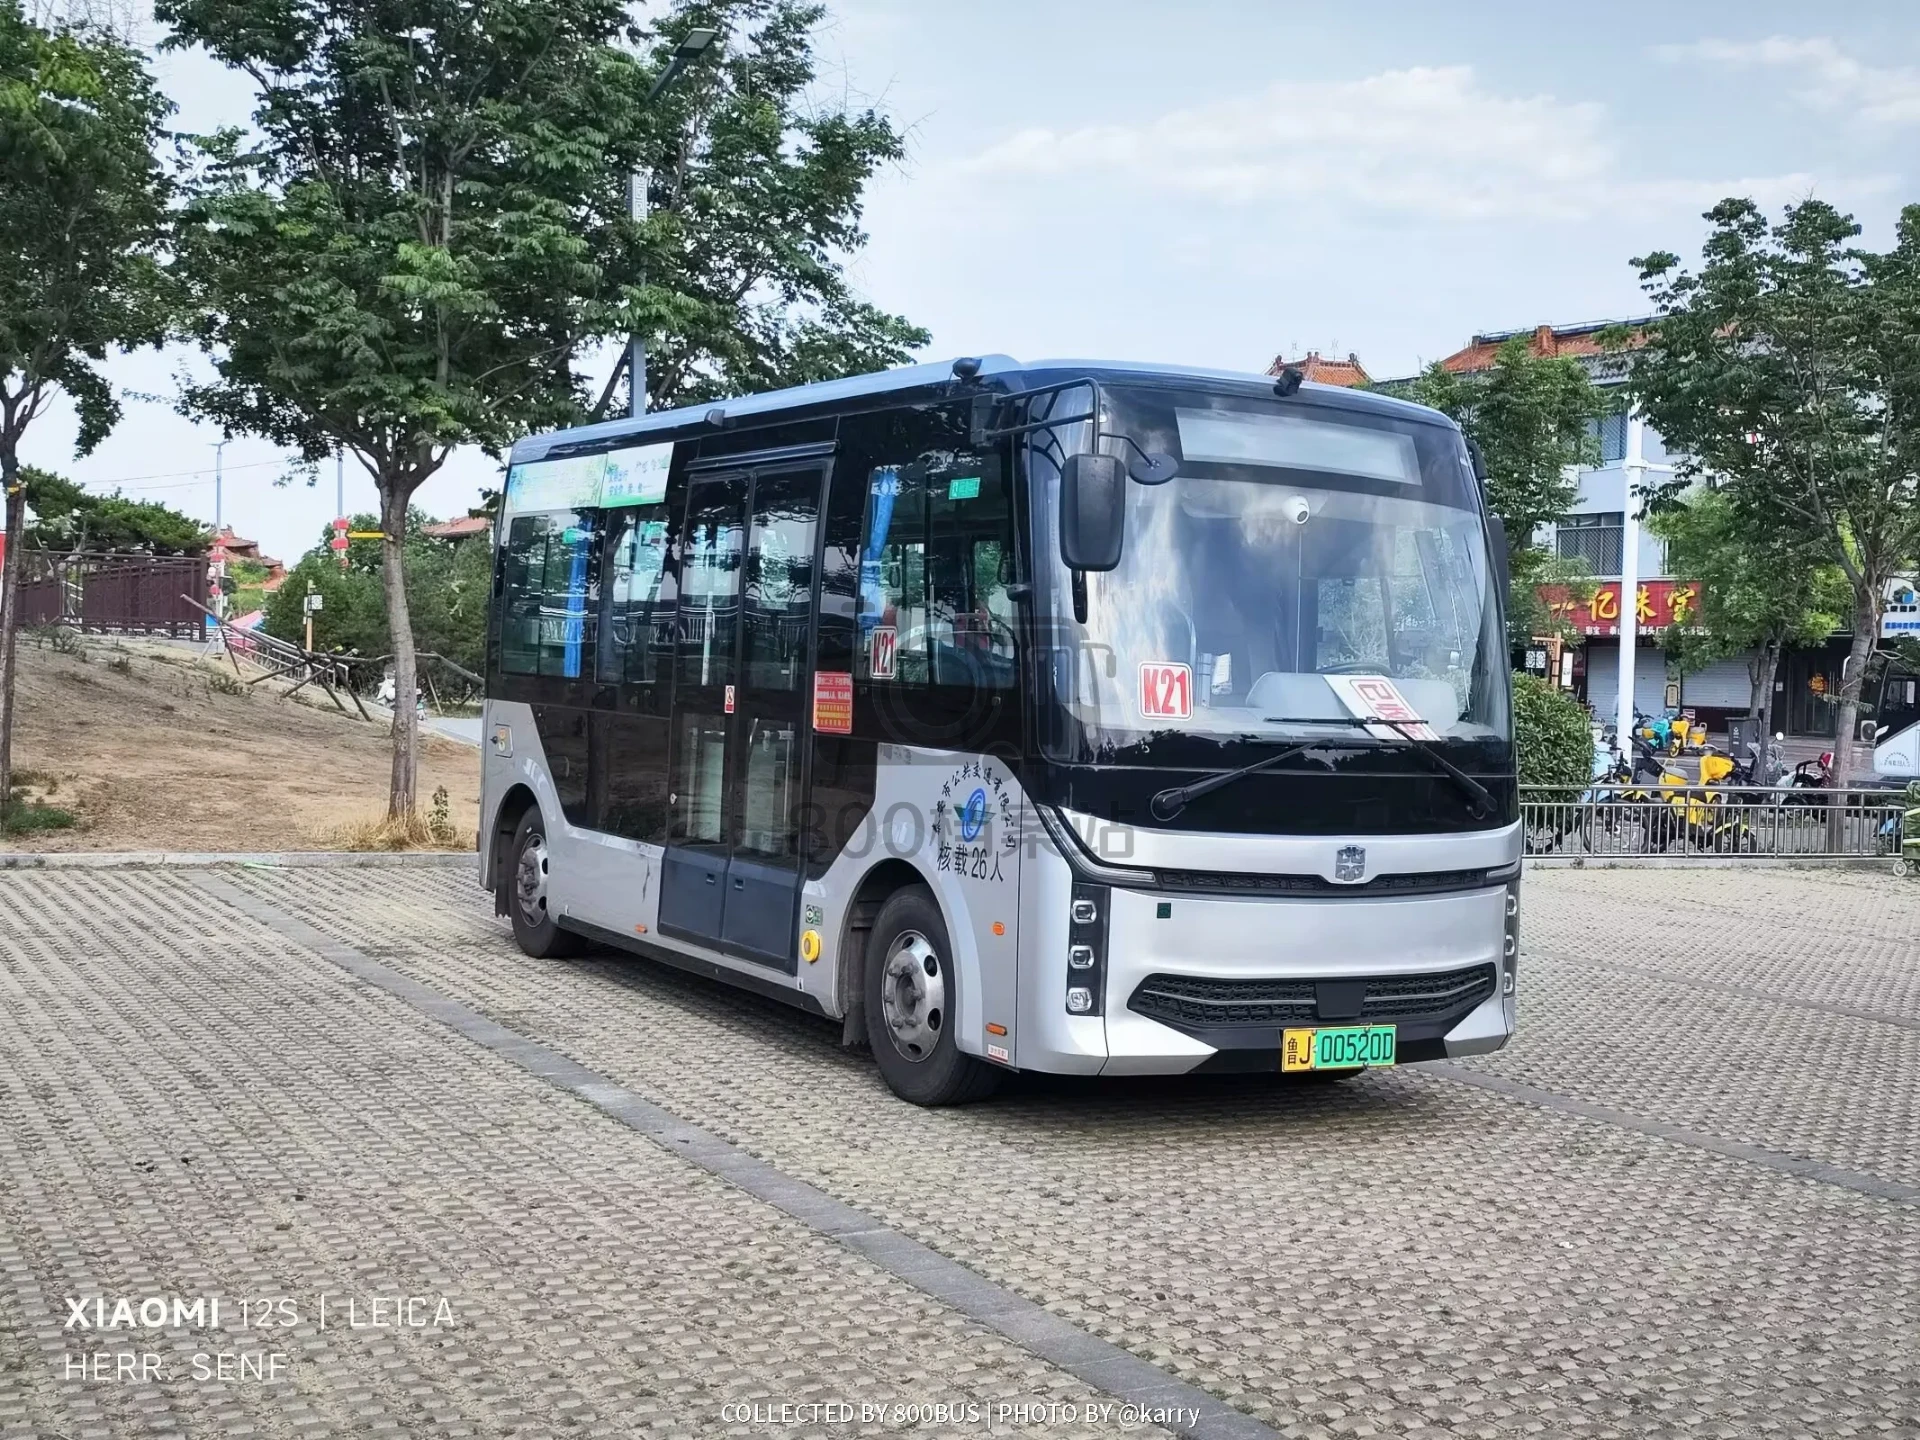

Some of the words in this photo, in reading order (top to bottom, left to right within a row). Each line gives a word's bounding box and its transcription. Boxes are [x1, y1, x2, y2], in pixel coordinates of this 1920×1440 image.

[873, 632, 894, 673] K21
[1143, 668, 1188, 715] K21
[937, 841, 1004, 882] 核载26人
